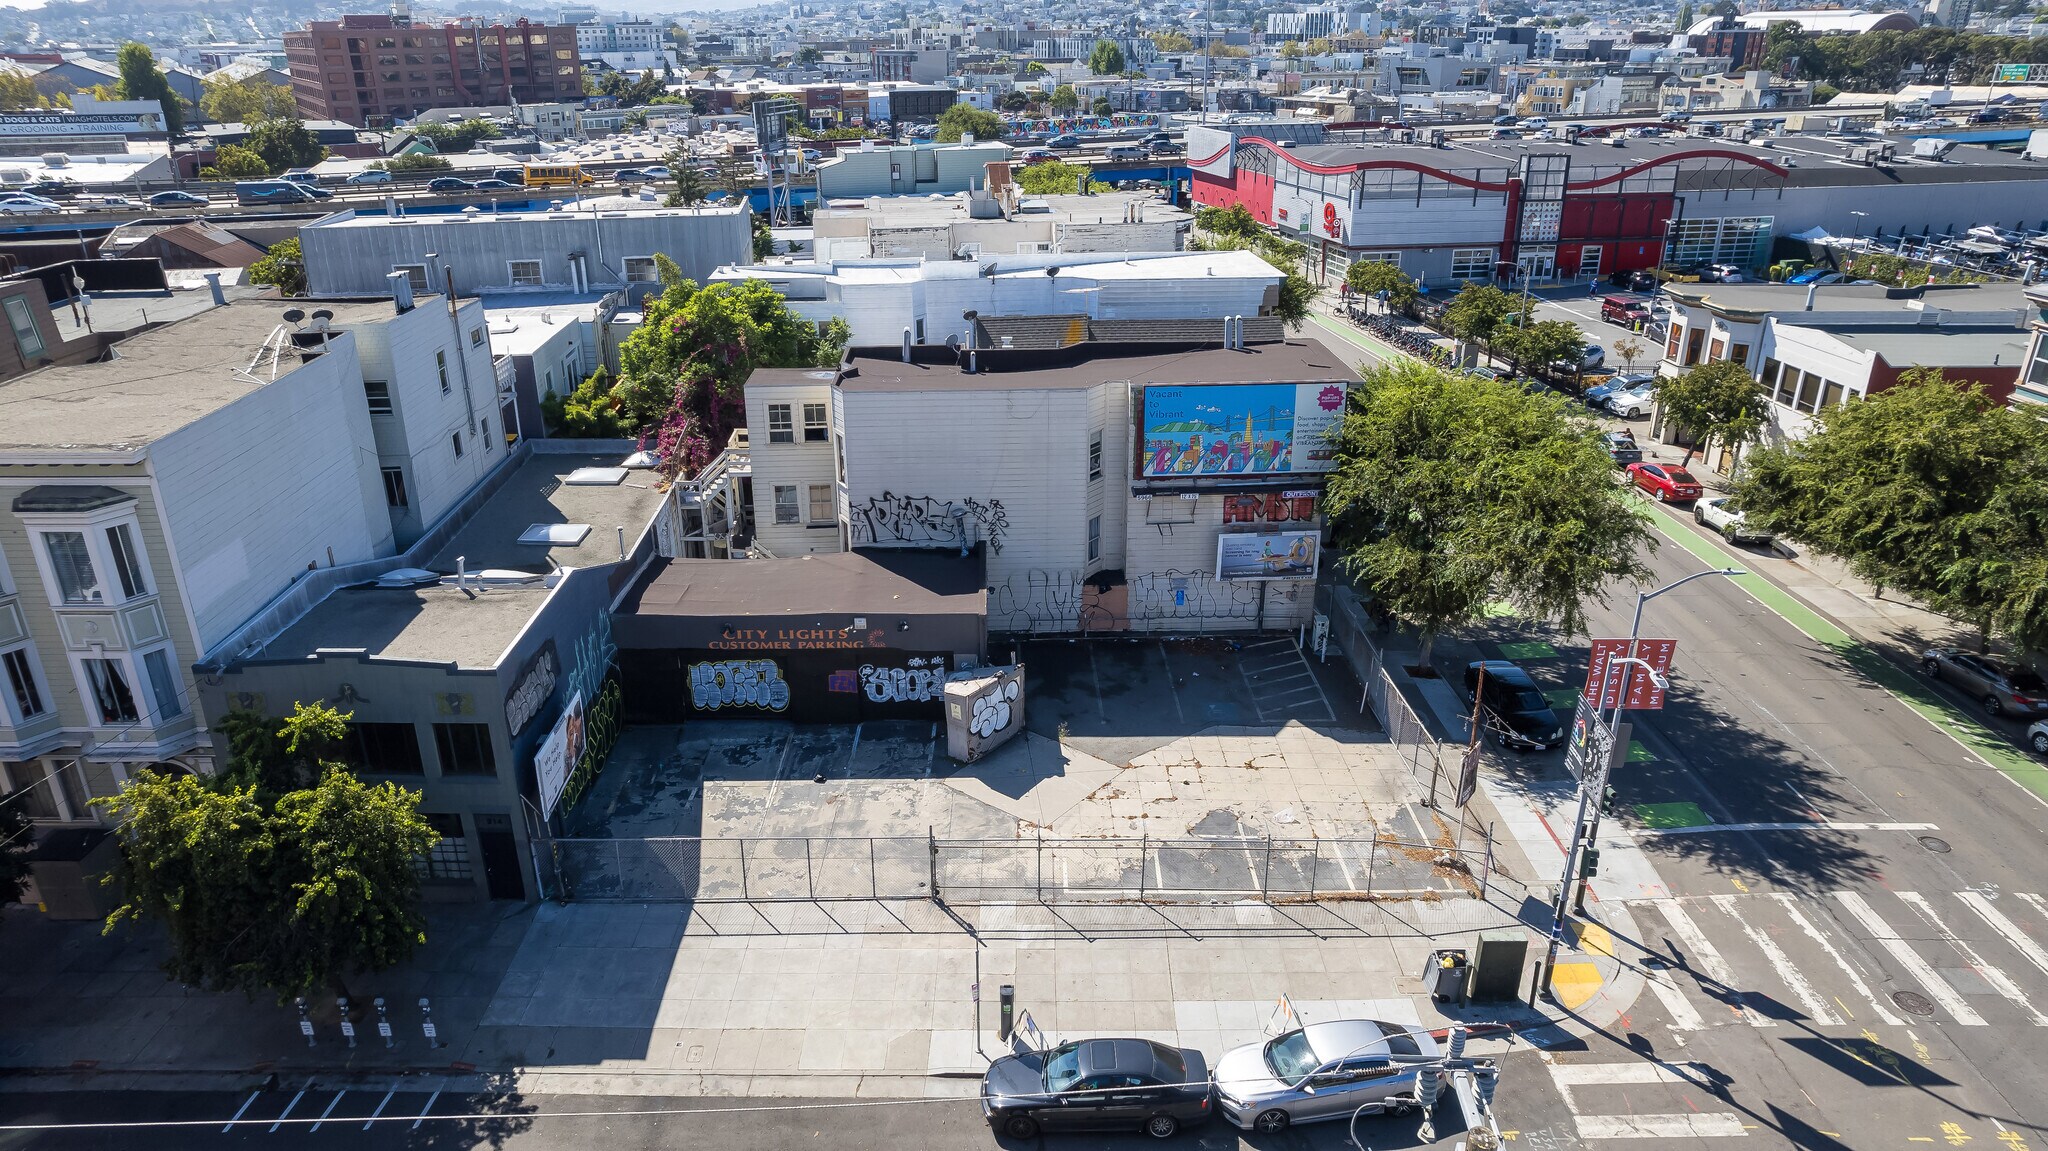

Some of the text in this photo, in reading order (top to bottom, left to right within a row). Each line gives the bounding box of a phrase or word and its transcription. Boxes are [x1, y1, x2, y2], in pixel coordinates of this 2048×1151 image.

[708, 641, 864, 649] CUSTOMER PARKING
[723, 629, 848, 640] CITY LIGHTS
[1587, 644, 1606, 702] THE WALT
[1631, 644, 1651, 704] FAMILY
[1650, 644, 1670, 704] MUEUM
